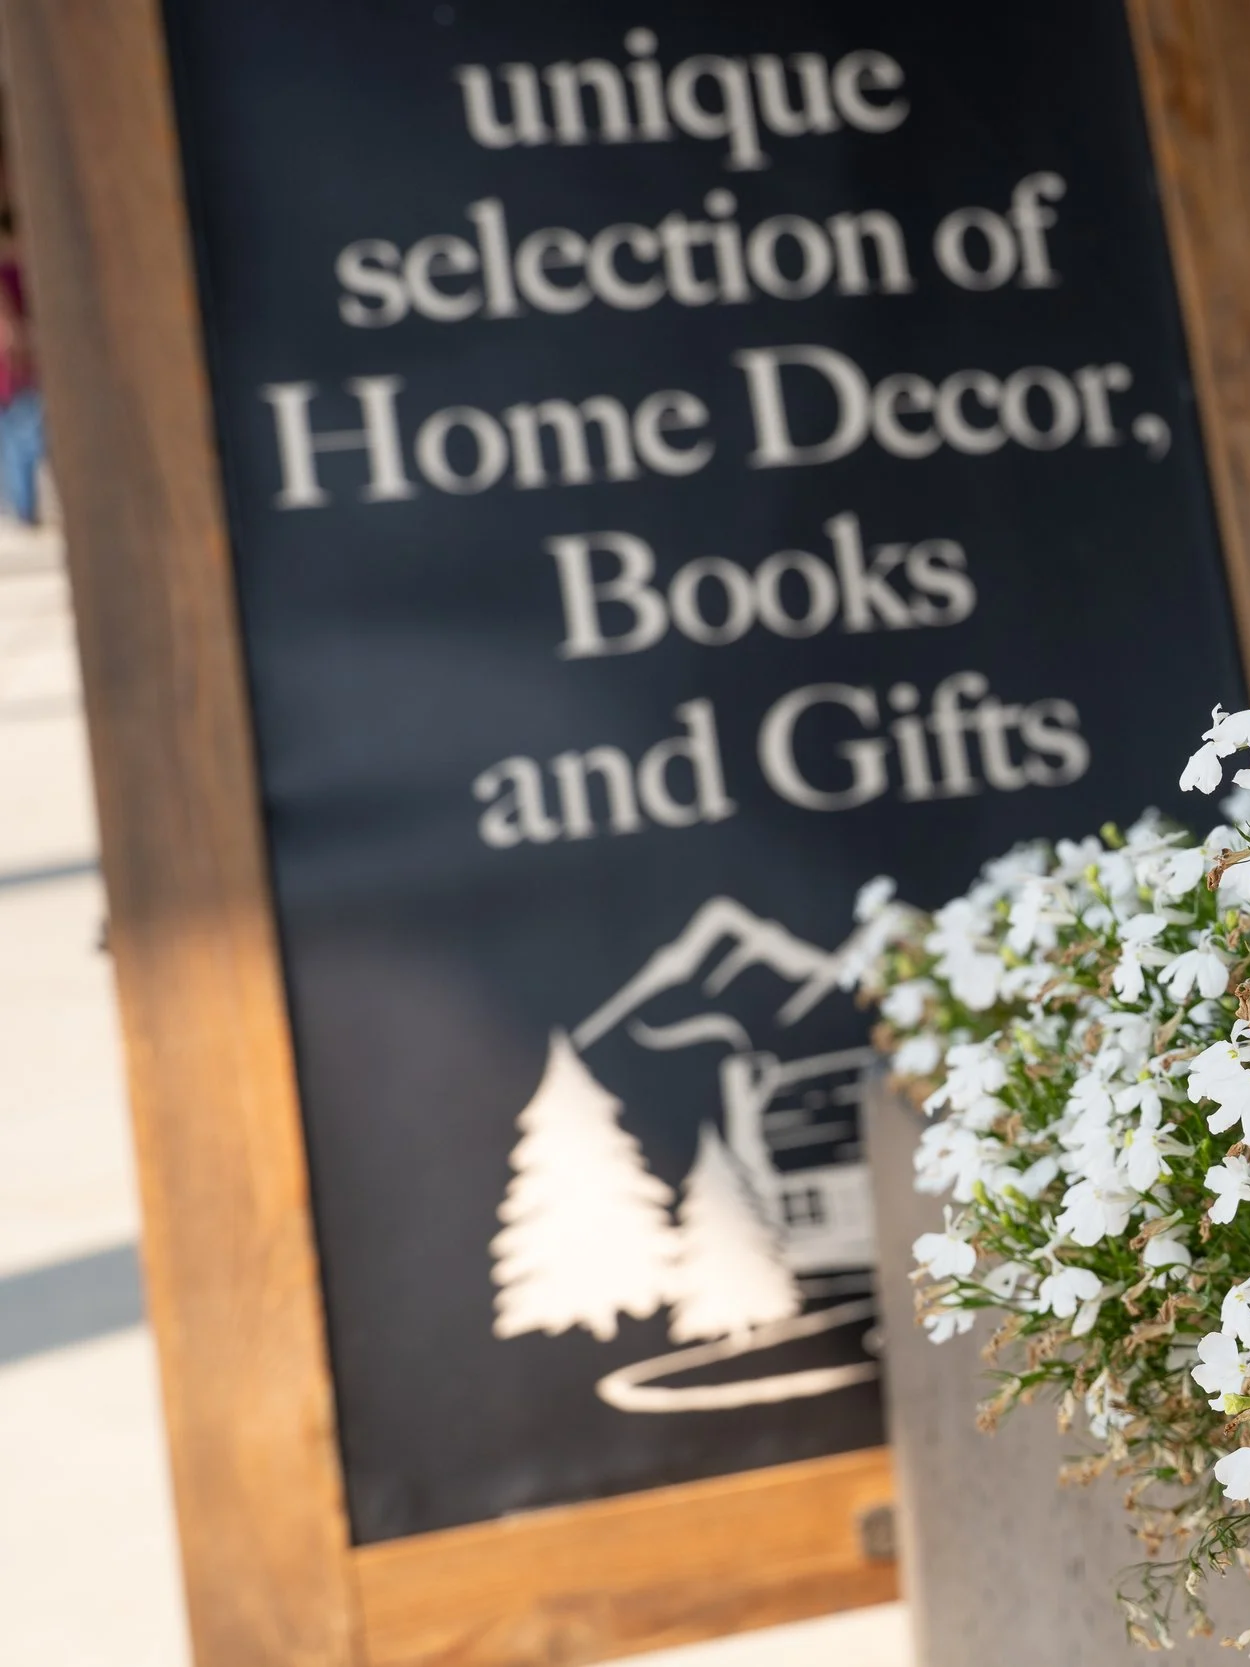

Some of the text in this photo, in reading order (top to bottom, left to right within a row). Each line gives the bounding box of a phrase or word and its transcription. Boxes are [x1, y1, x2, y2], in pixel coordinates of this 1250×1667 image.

[456, 27, 909, 170] unique
[337, 172, 1066, 328] selection of
[262, 343, 1172, 510] Home Decor,
[544, 511, 977, 660] Books
[472, 670, 1091, 849] and Gifts
